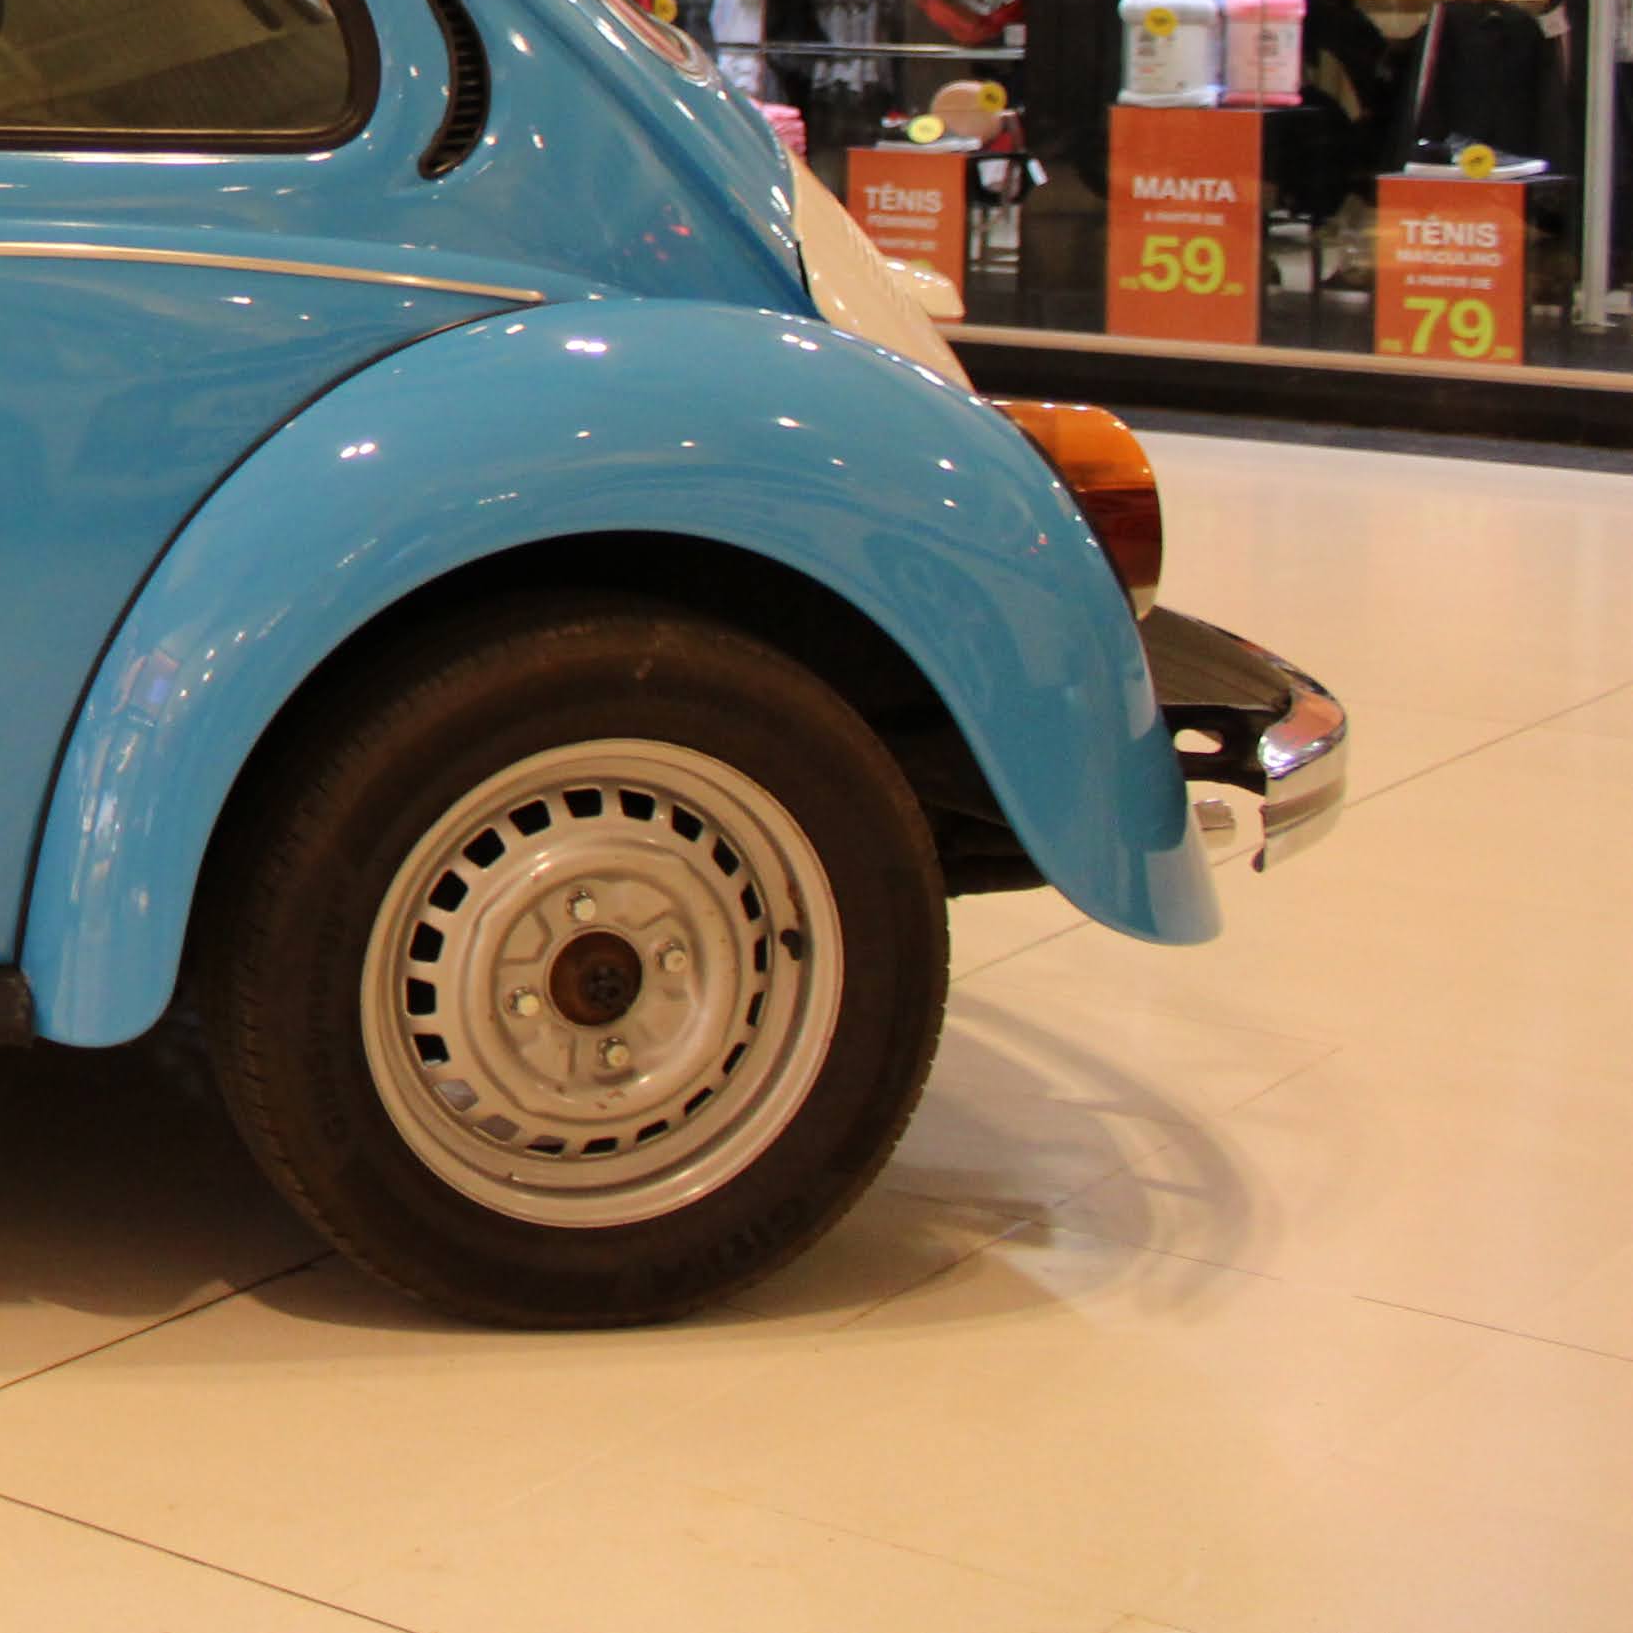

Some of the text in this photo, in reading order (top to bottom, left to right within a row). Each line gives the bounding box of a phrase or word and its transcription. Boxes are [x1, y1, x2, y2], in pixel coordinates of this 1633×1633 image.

[863, 182, 943, 213] TÊNIS
[1131, 175, 1237, 203] MANTA
[1399, 214, 1500, 248] TÊNIS
[1138, 234, 1226, 294] 59
[1404, 296, 1495, 358] 79
